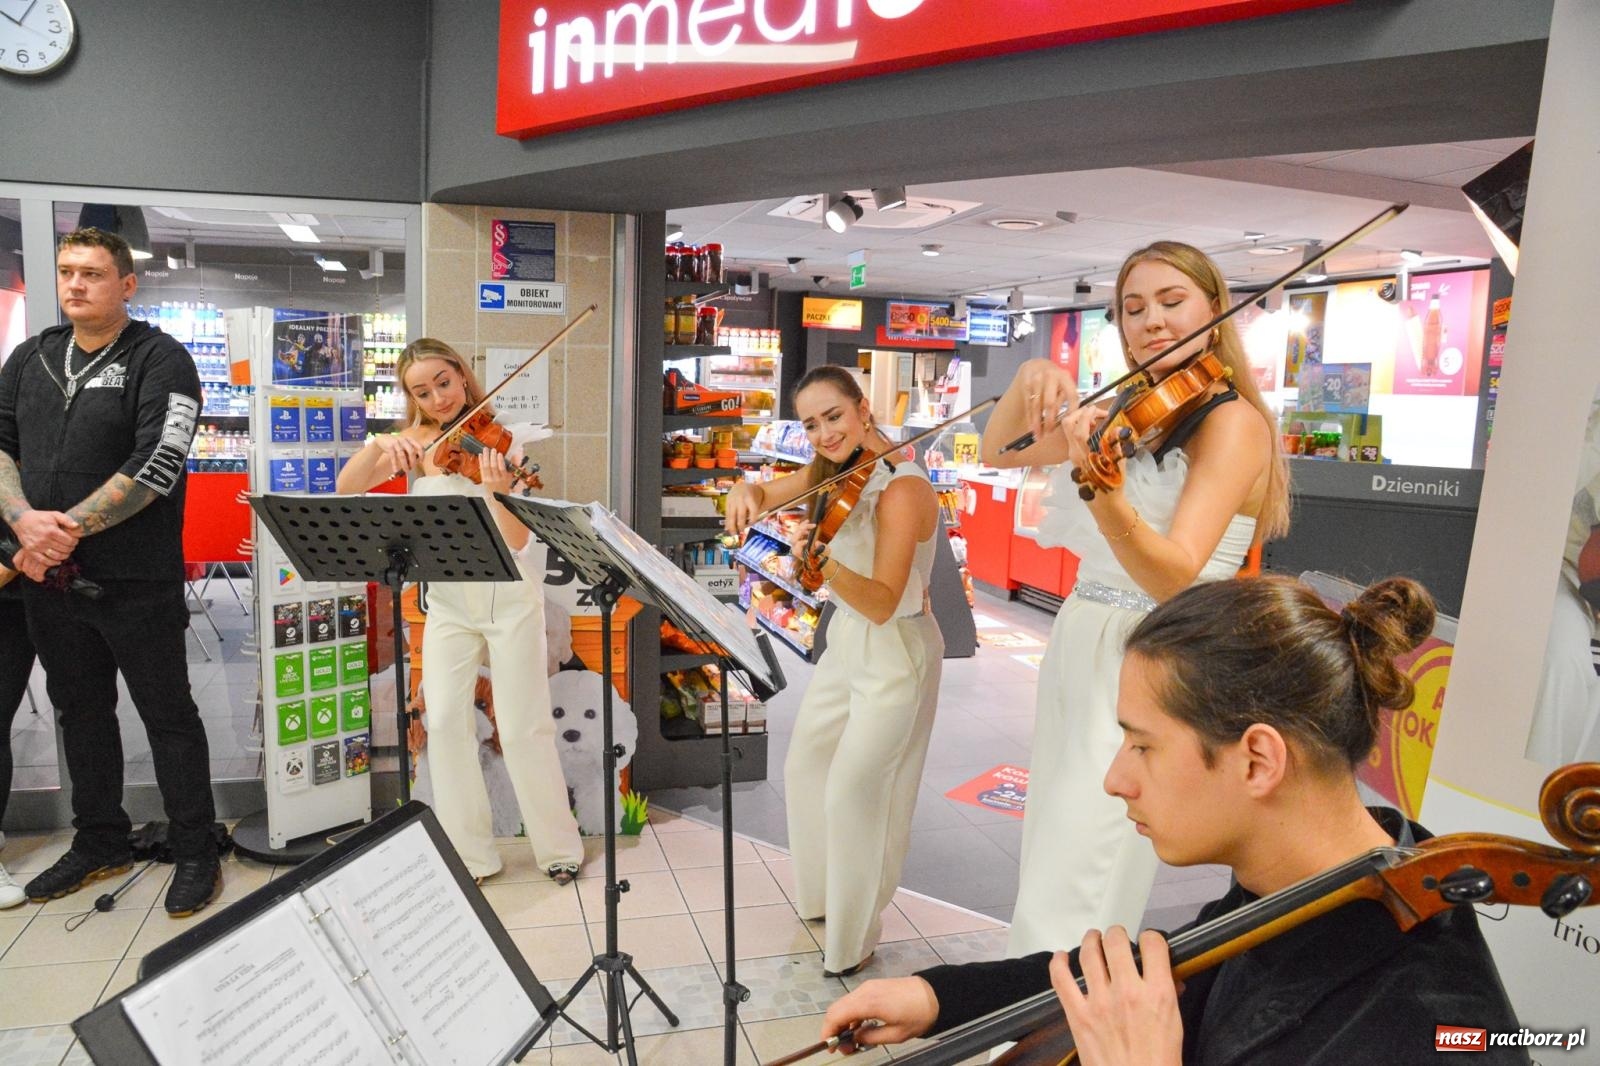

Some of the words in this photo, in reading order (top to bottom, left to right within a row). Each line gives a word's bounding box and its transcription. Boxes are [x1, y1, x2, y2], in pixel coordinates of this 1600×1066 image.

[48, 20, 62, 34] 3
[529, 0, 925, 94] inme
[16, 49, 30, 64] 6
[520, 288, 549, 298] OBIEKT
[507, 299, 562, 309] MONITOROWANY
[288, 324, 315, 332] IDEALNY
[721, 395, 740, 411] GO!
[1372, 475, 1460, 497] Dzienniki
[544, 547, 594, 586] 5
[1553, 919, 1600, 955] trio
